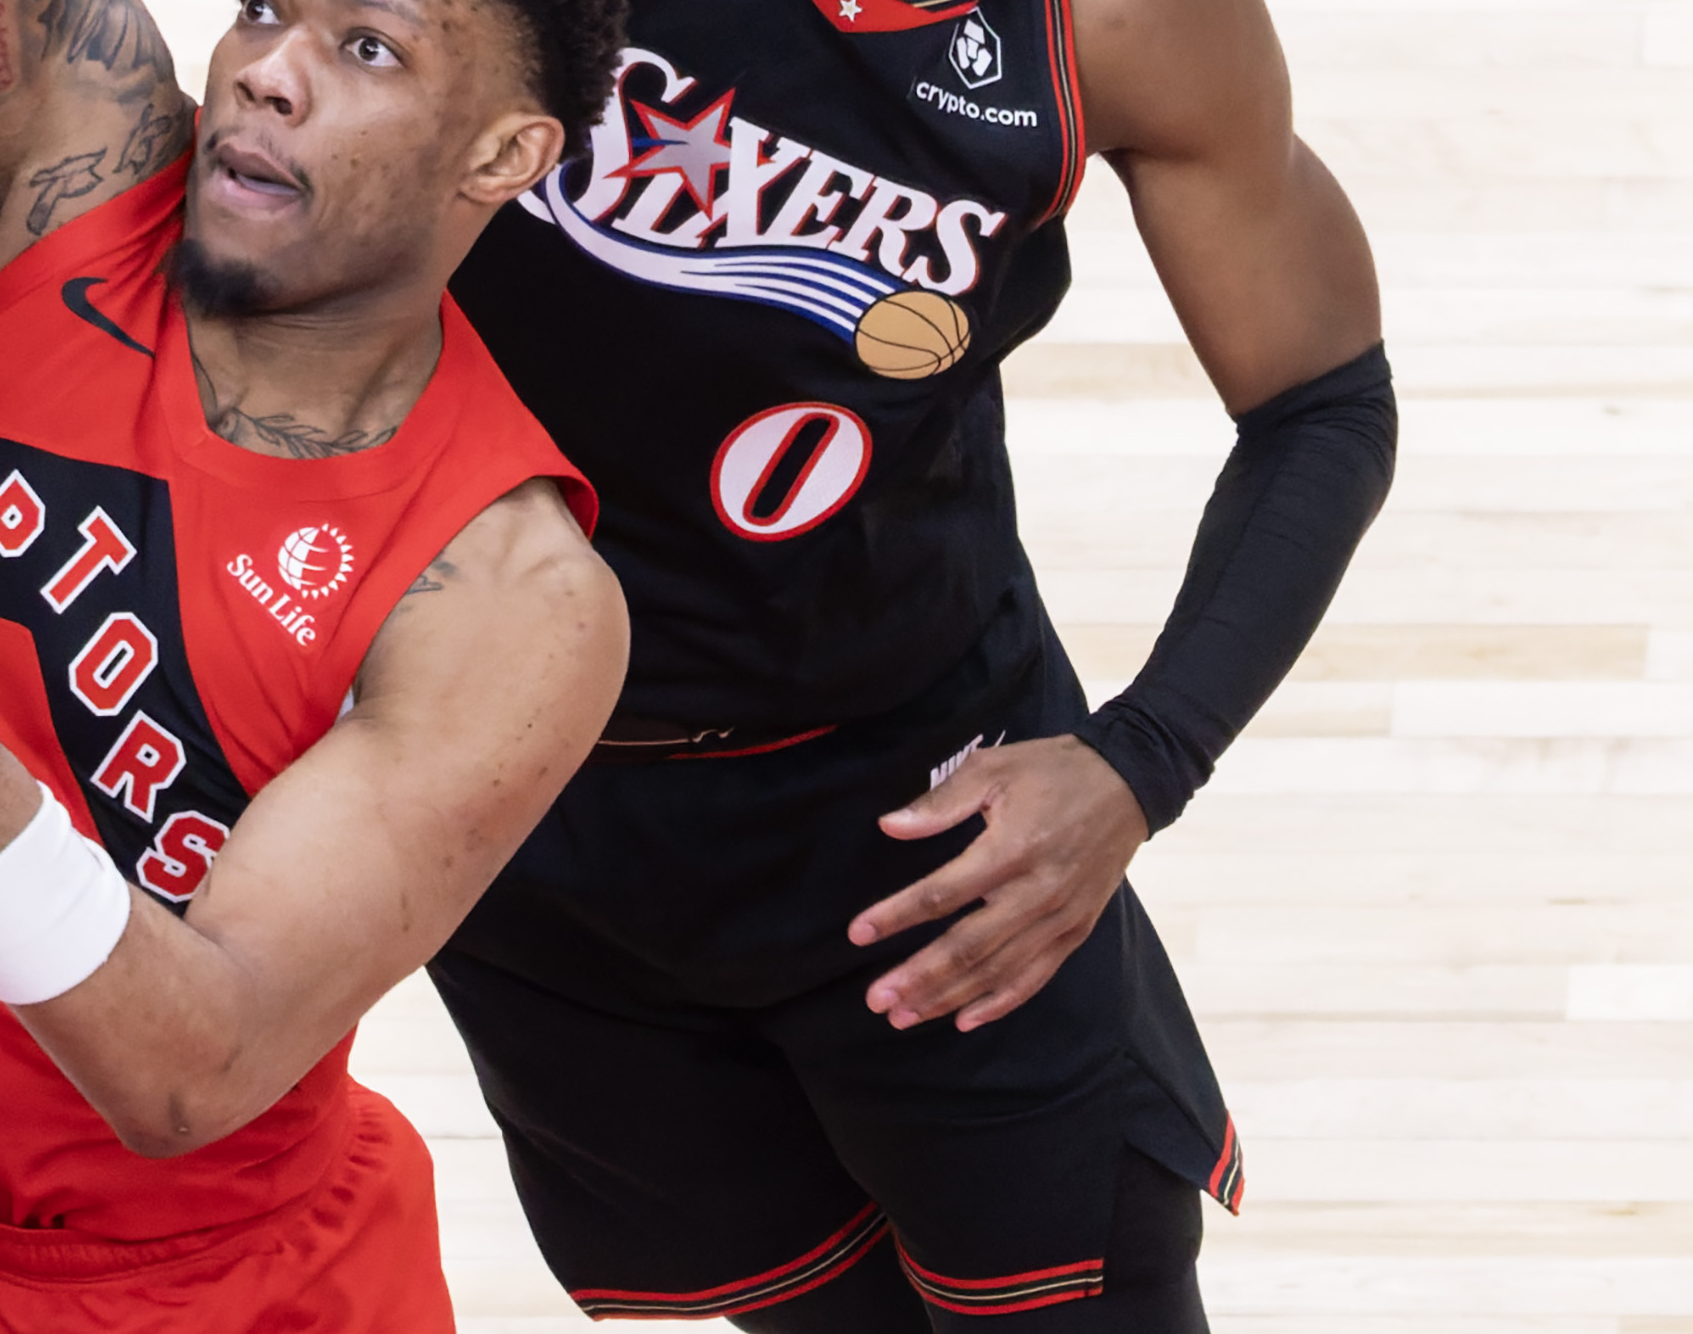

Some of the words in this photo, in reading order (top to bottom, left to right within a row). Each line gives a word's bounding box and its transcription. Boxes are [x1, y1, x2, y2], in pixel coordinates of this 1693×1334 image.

[915, 80, 1038, 128] crypto.com
[516, 46, 1006, 297] SIXERS
[710, 402, 873, 542] 0
[226, 553, 275, 606] Sun
[268, 592, 317, 647] Life
